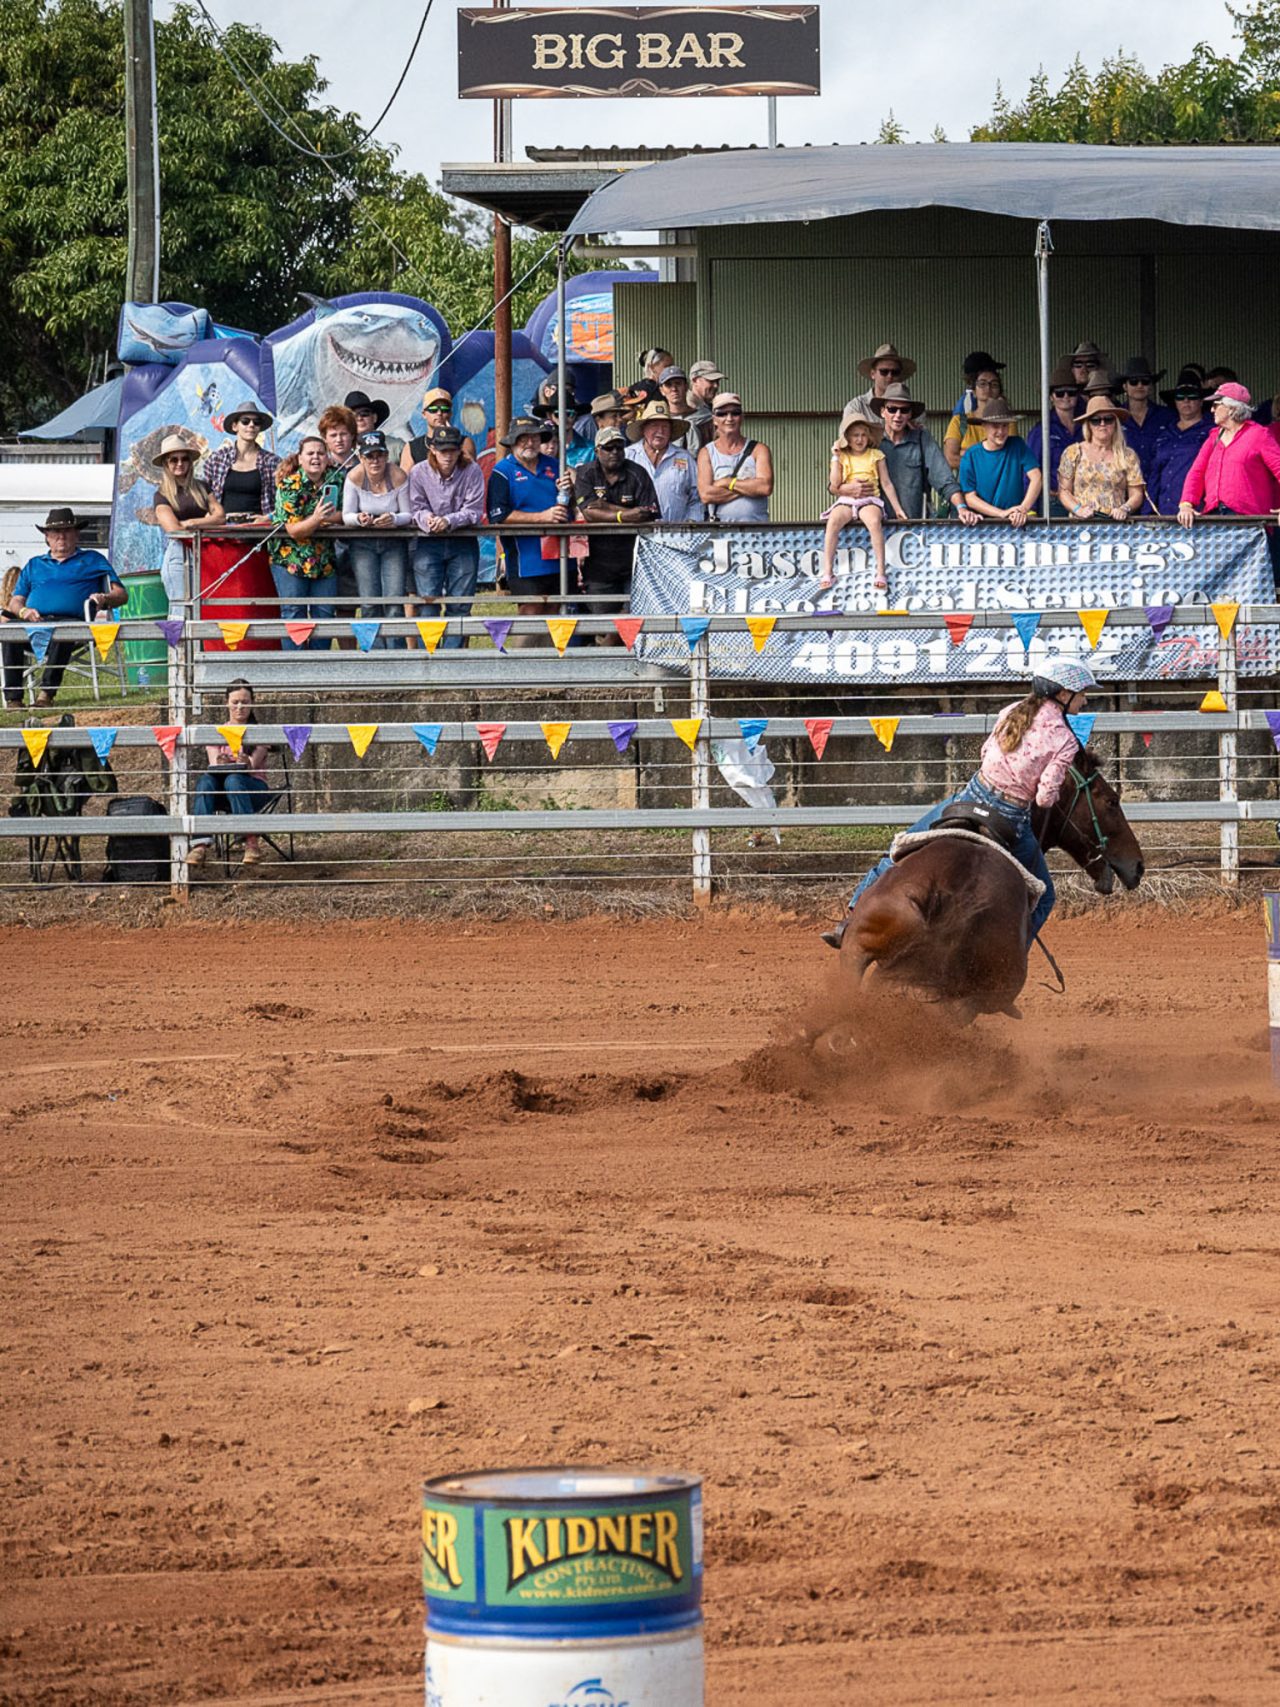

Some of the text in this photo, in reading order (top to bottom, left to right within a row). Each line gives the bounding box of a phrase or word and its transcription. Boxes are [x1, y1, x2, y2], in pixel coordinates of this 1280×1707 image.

[532, 32, 746, 69] BIG BAR
[700, 530, 1195, 580] Jason Cummings
[791, 639, 948, 676] 4091
[504, 1510, 684, 1590] KIDNER
[533, 1556, 657, 1590] CONTRACTING
